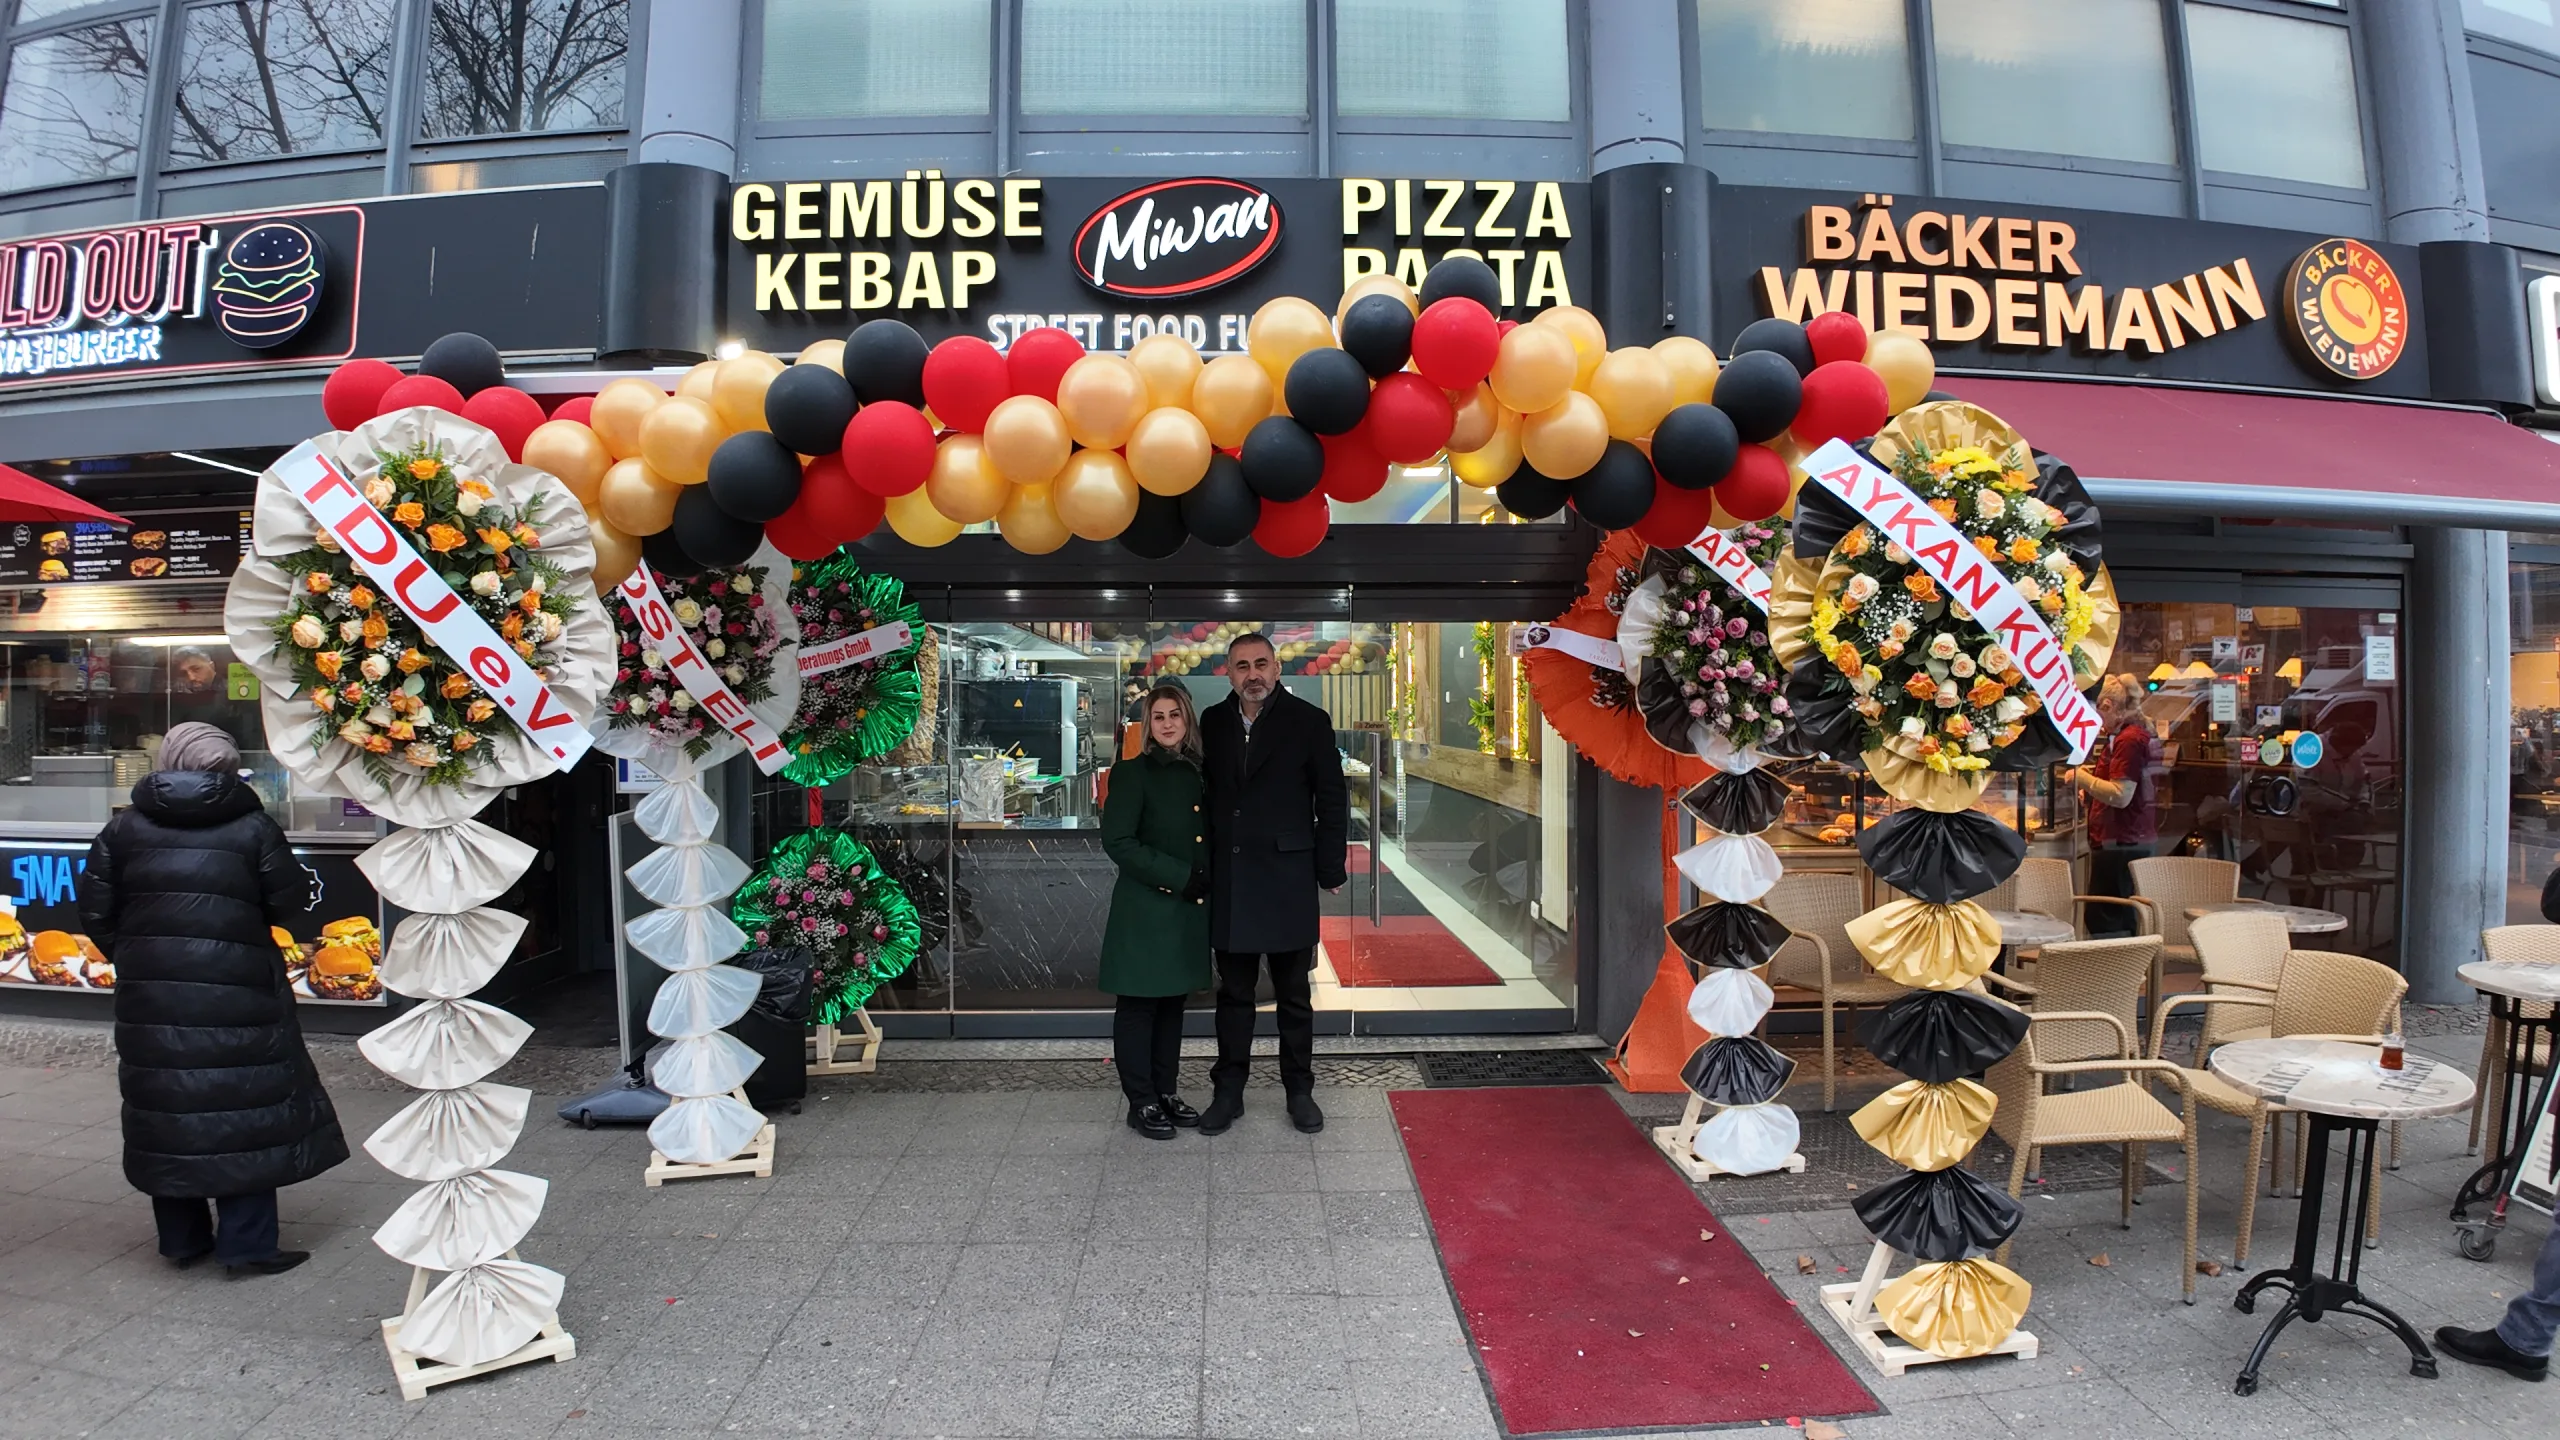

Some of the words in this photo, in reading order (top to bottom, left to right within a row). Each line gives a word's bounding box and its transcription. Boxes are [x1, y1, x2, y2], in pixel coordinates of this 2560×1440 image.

[731, 168, 1043, 242] GEMÜSE
[1093, 192, 1270, 287] Miwan
[1342, 178, 1573, 239] PIZZA
[1808, 193, 2083, 276] BÄCKER
[81, 222, 203, 320] OUT
[754, 250, 997, 312] KEBAP
[1342, 247, 1573, 307] PATA
[1758, 256, 2267, 354] WIEDEMANN
[2304, 246, 2392, 295] BÄCKER
[2301, 296, 2400, 372] WIEDEMANN
[302, 453, 462, 625] TDU
[1819, 462, 2001, 612] AYKAN
[1993, 607, 2099, 751] KÜTÜK
[843, 636, 873, 659] GmbH
